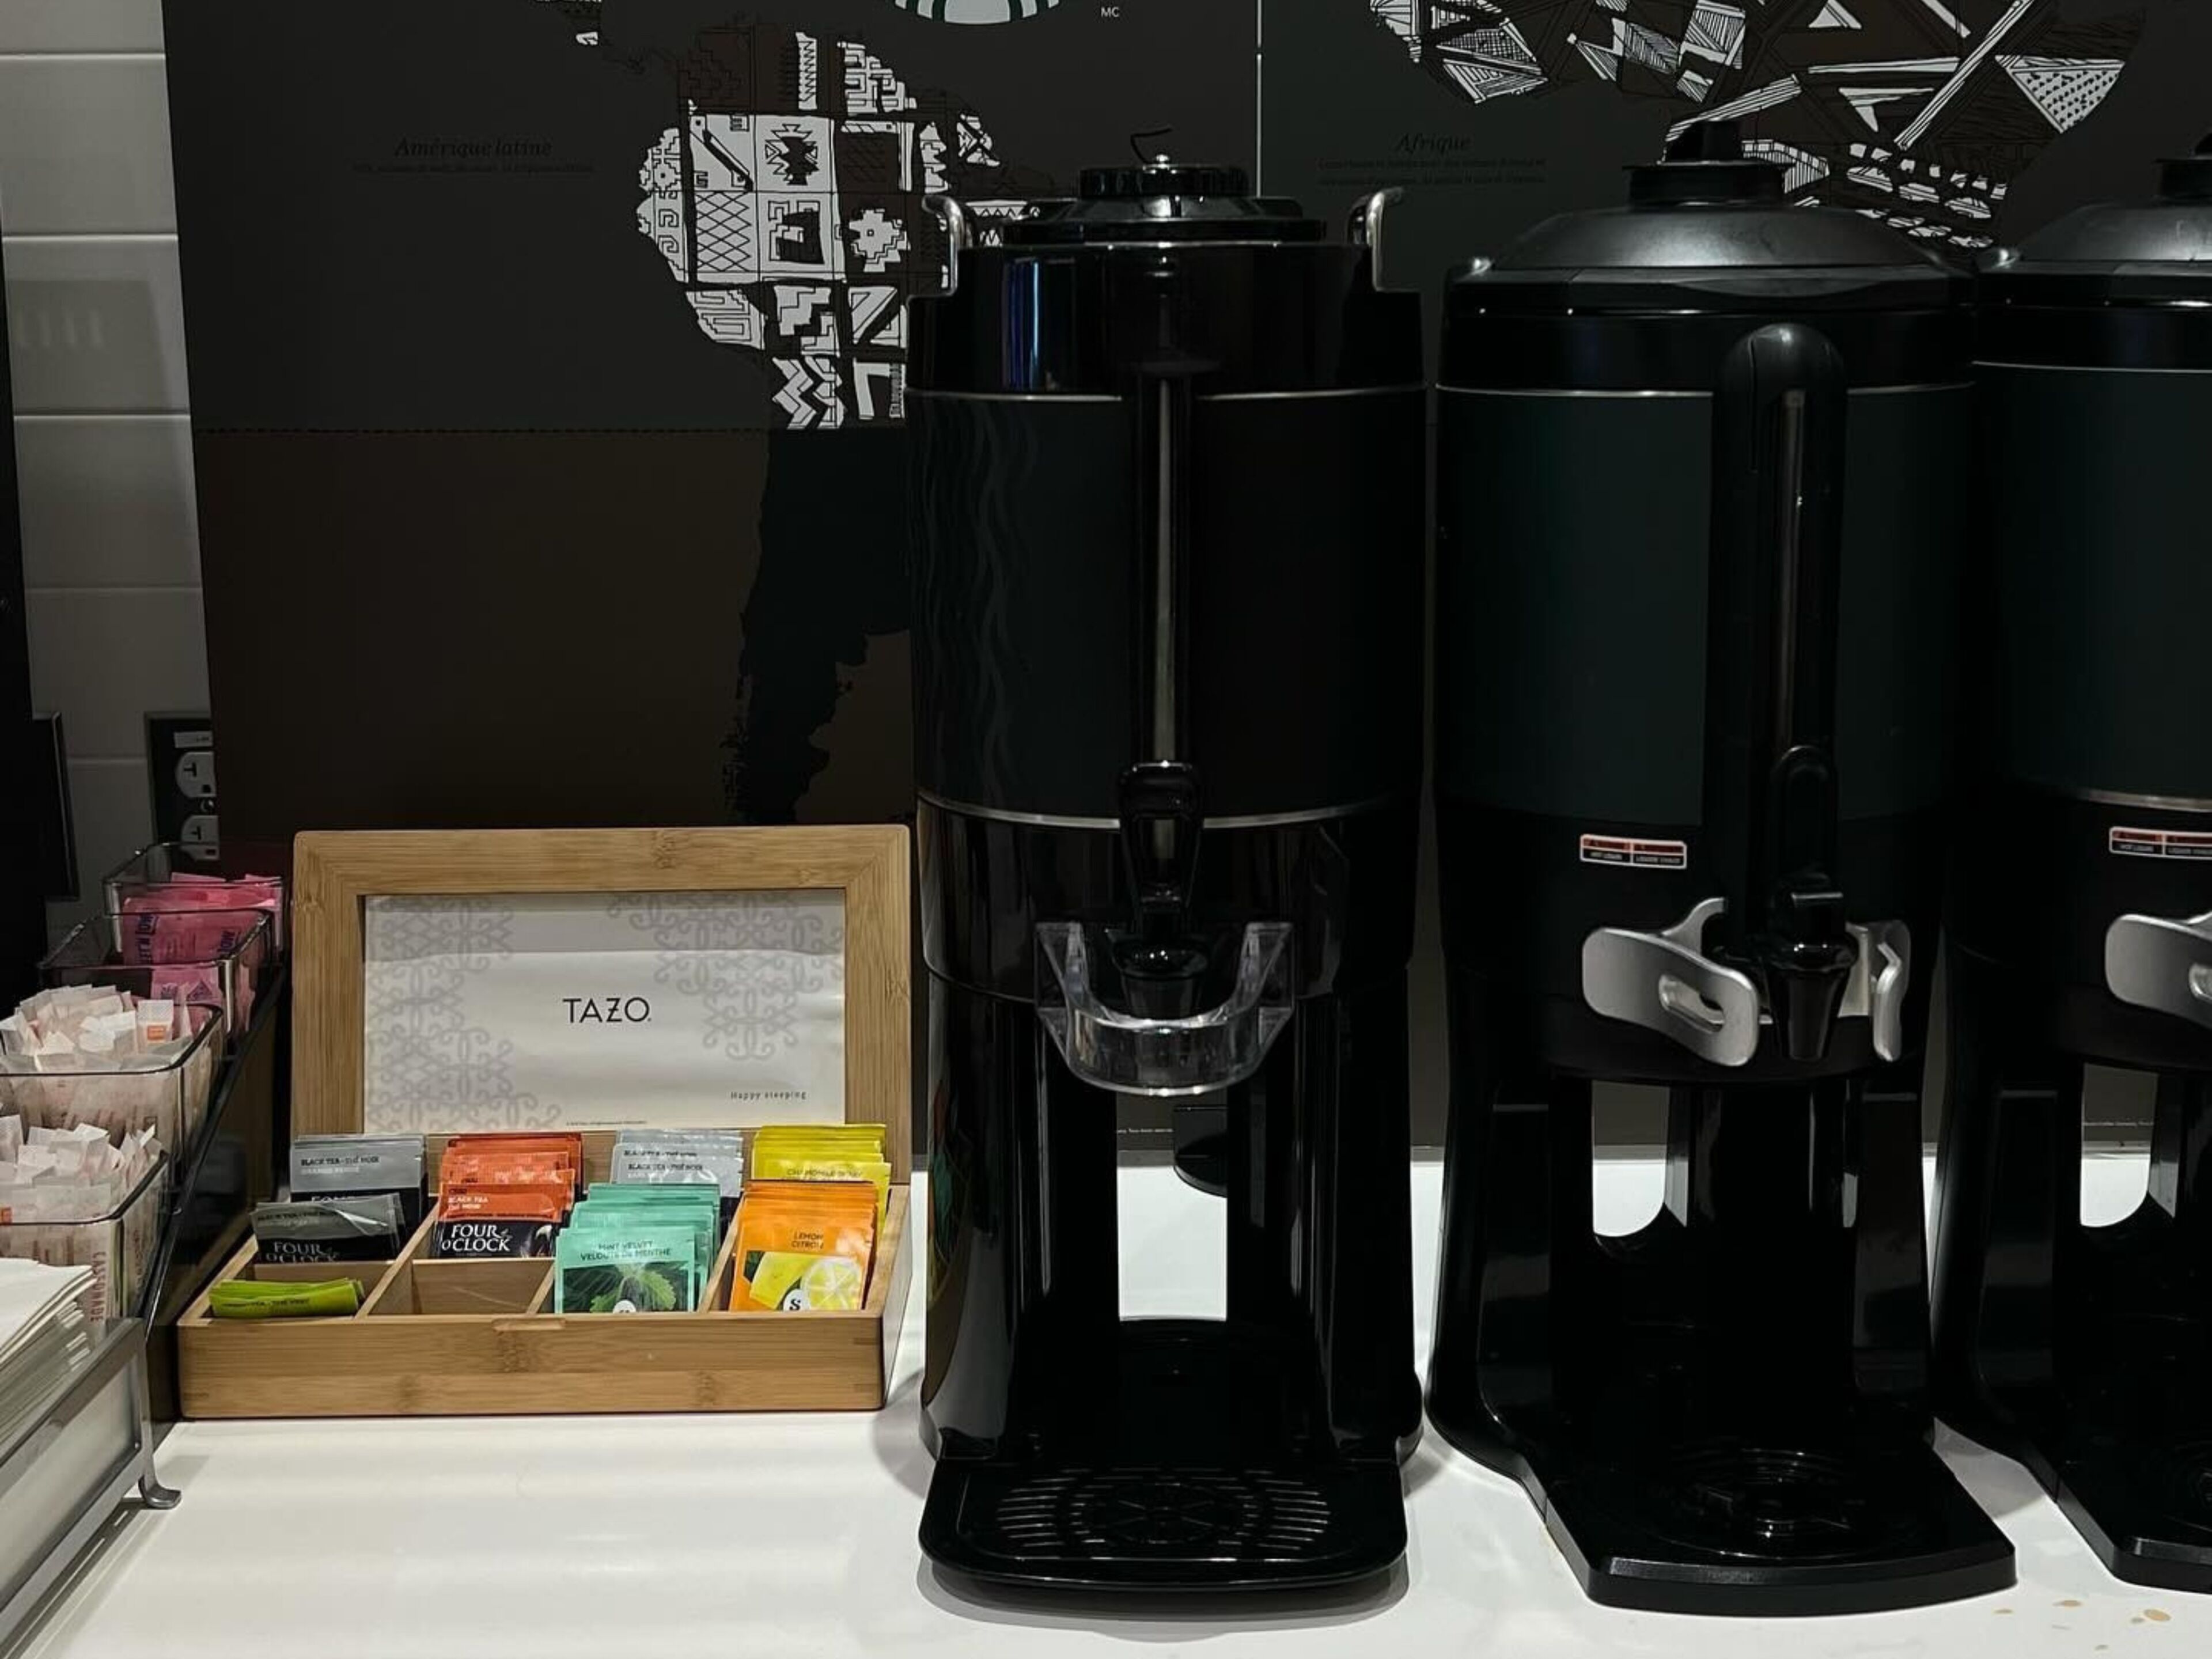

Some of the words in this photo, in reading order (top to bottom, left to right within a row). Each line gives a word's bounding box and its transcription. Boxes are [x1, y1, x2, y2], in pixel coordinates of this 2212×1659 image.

[1101, 6, 1119, 17] MC
[393, 137, 493, 158] Amérique
[495, 138, 552, 157] latine
[1395, 132, 1471, 155] Afrique
[730, 1092, 761, 1101] Happy
[452, 1224, 501, 1238] FOUR
[274, 1241, 324, 1255] FOUR
